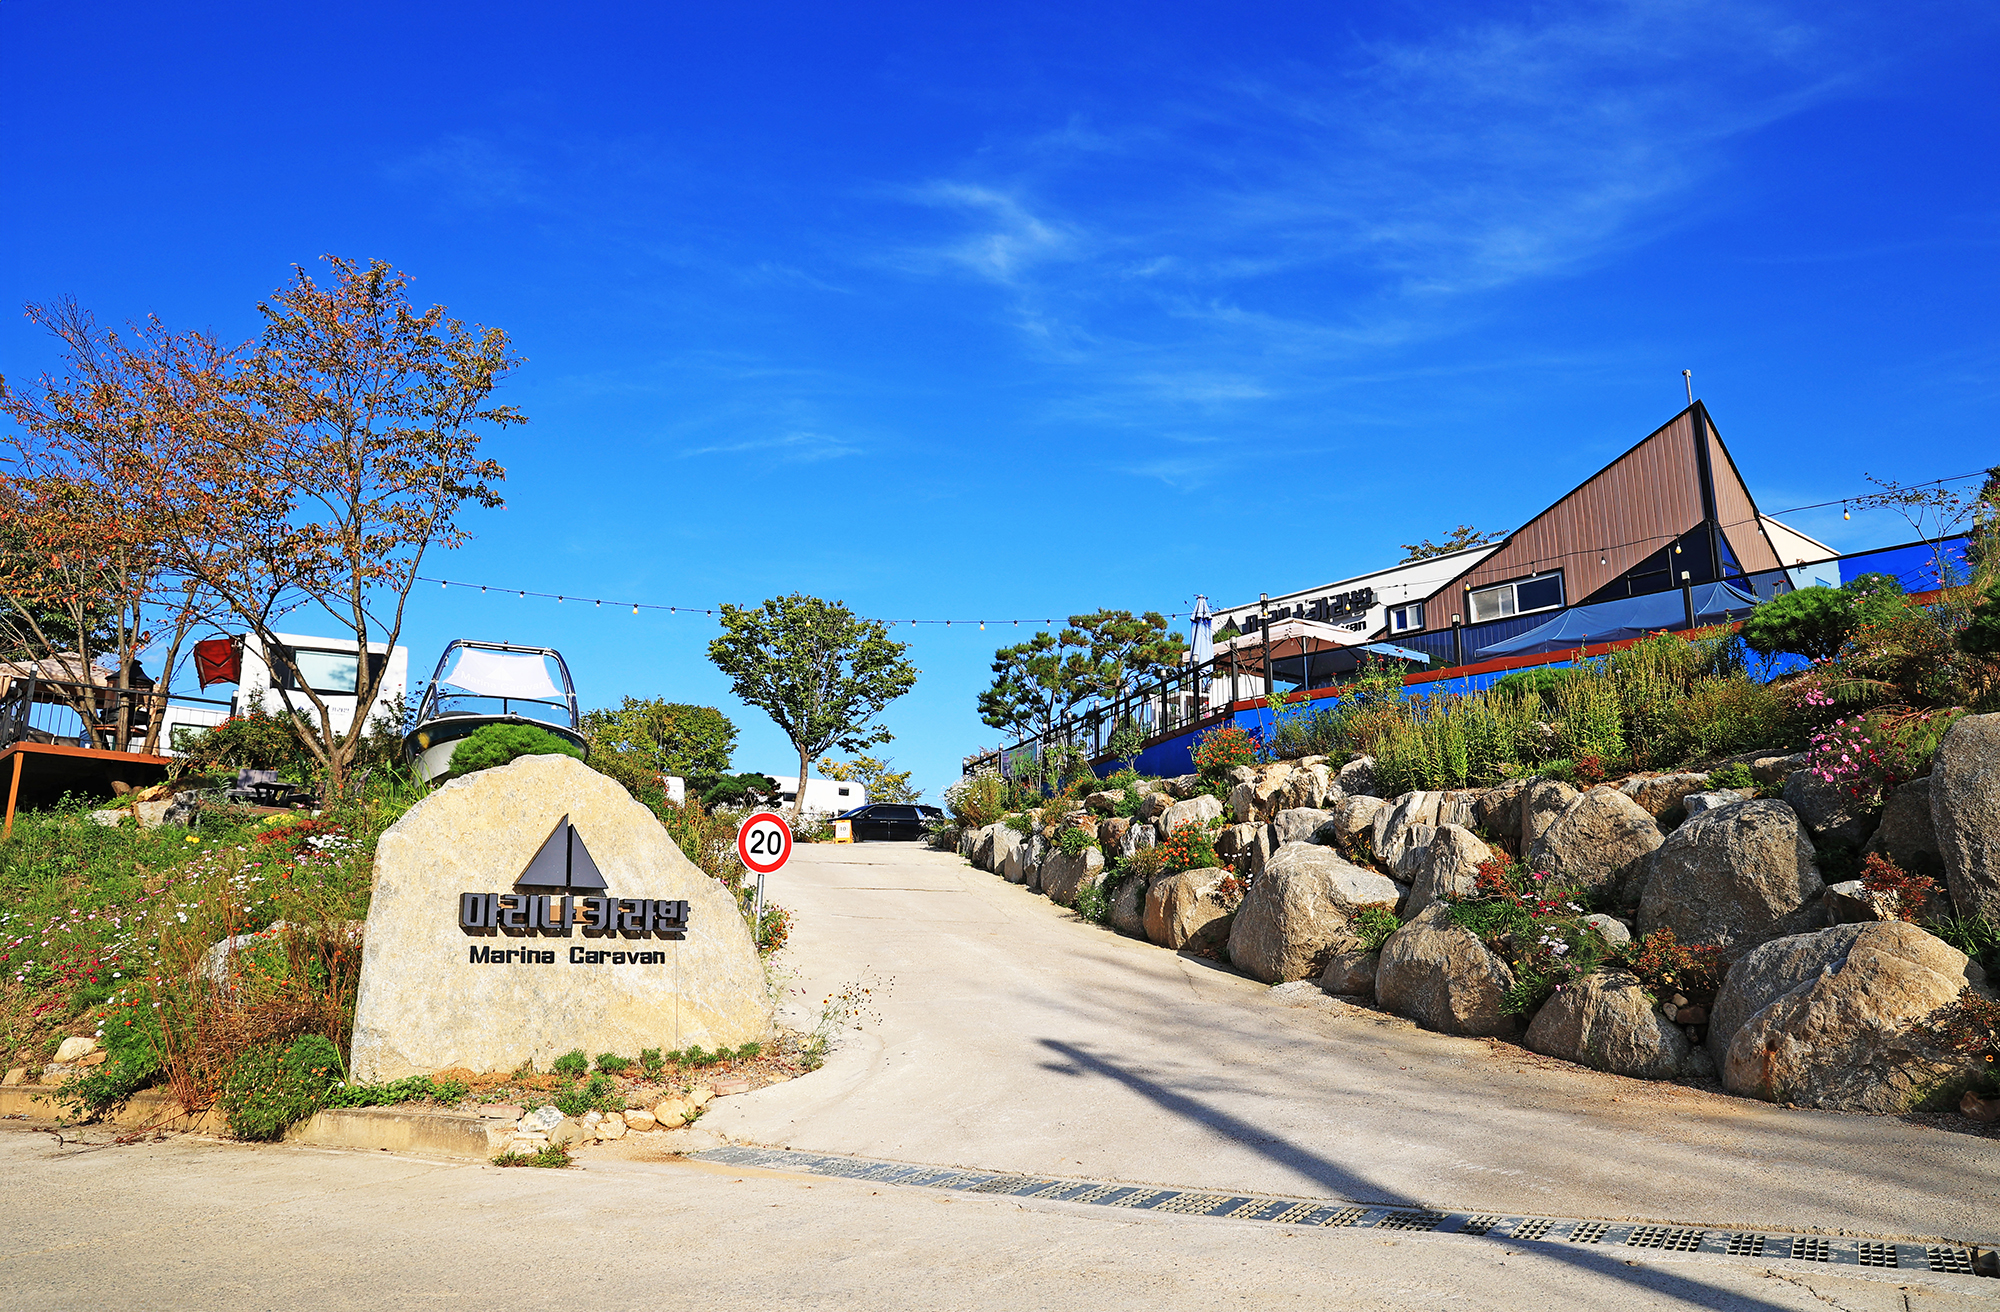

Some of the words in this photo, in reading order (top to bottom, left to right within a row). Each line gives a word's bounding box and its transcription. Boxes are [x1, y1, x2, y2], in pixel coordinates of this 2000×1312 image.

[460, 670, 498, 690] Marina
[500, 680, 546, 691] Caravan
[750, 829, 782, 856] 20
[470, 945, 555, 964] Marina
[569, 946, 666, 965] Caravan
